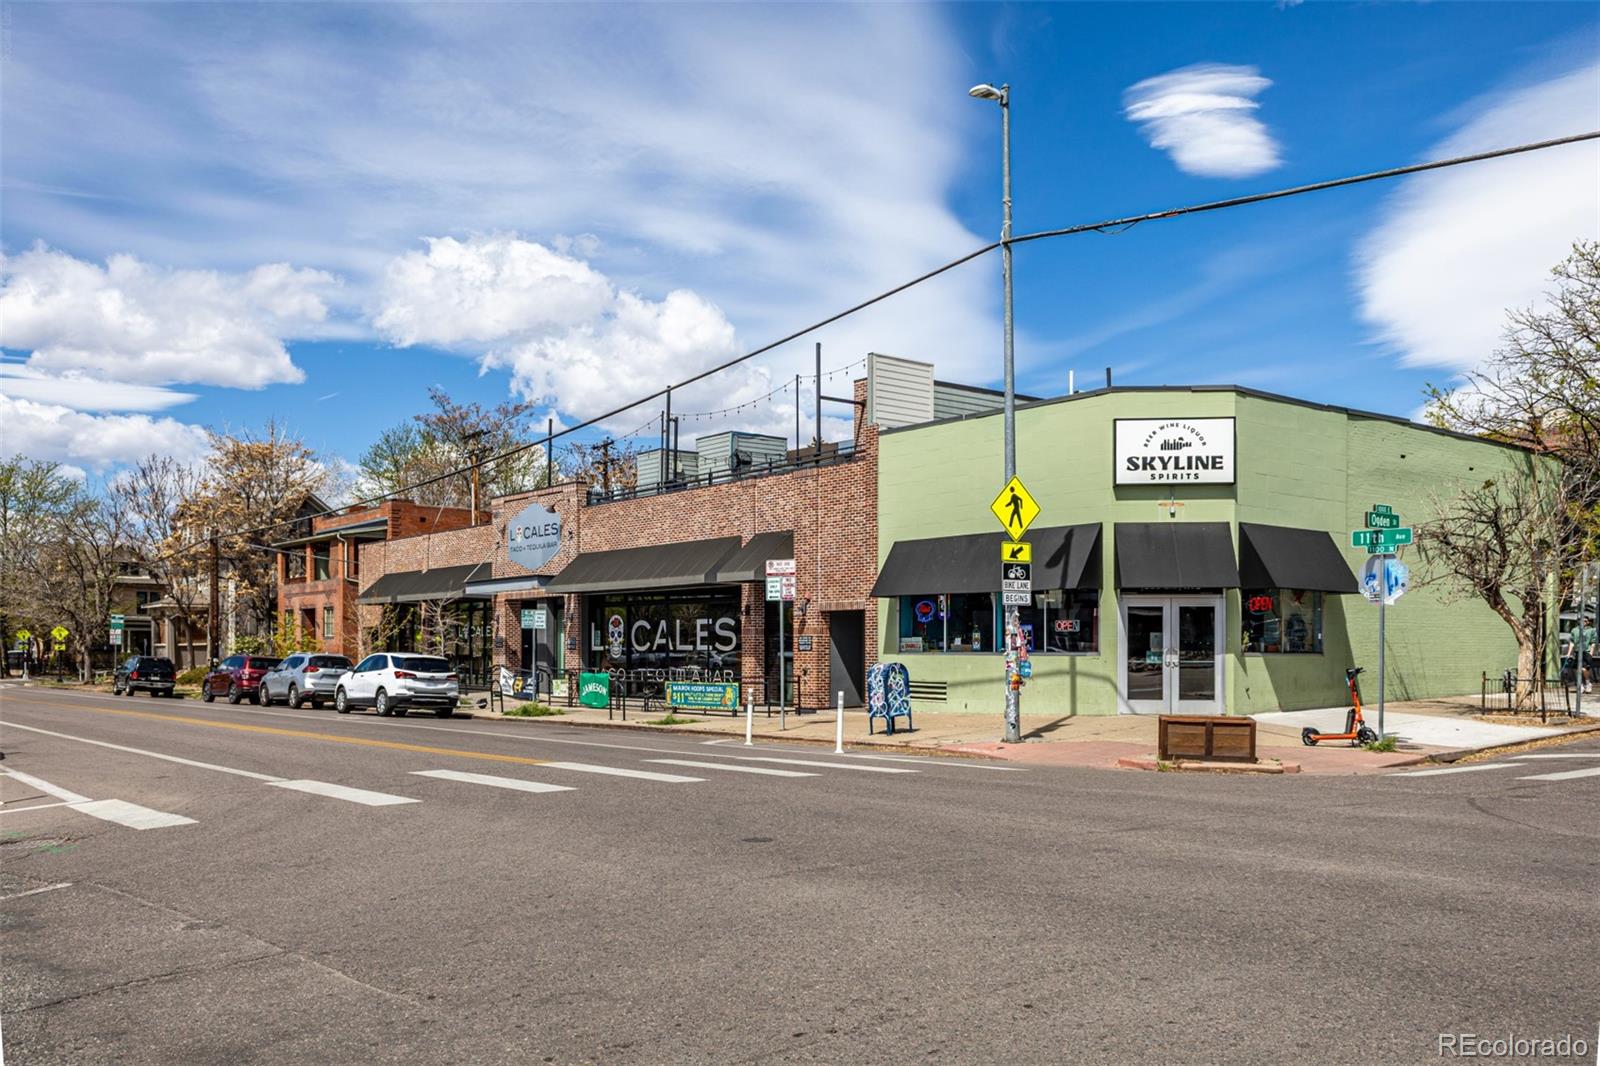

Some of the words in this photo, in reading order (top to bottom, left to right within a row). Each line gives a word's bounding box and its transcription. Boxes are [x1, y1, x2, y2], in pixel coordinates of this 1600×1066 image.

[1144, 430, 1157, 448] BEER
[1159, 422, 1180, 431] WINE
[1182, 424, 1207, 447] LIQUOR
[1126, 455, 1224, 471] SKYLINE
[1371, 513, 1391, 528] Ogden
[1360, 532, 1385, 545] 11th
[511, 545, 522, 553] TACO
[526, 543, 546, 551] TEQUILA
[1004, 581, 1015, 589] BIKE
[1016, 581, 1029, 590] LANE
[1005, 594, 1028, 602] BEGINS
[1249, 596, 1273, 612] OPEN
[1056, 620, 1080, 631] OPEN
[581, 682, 608, 696] JAMESON
